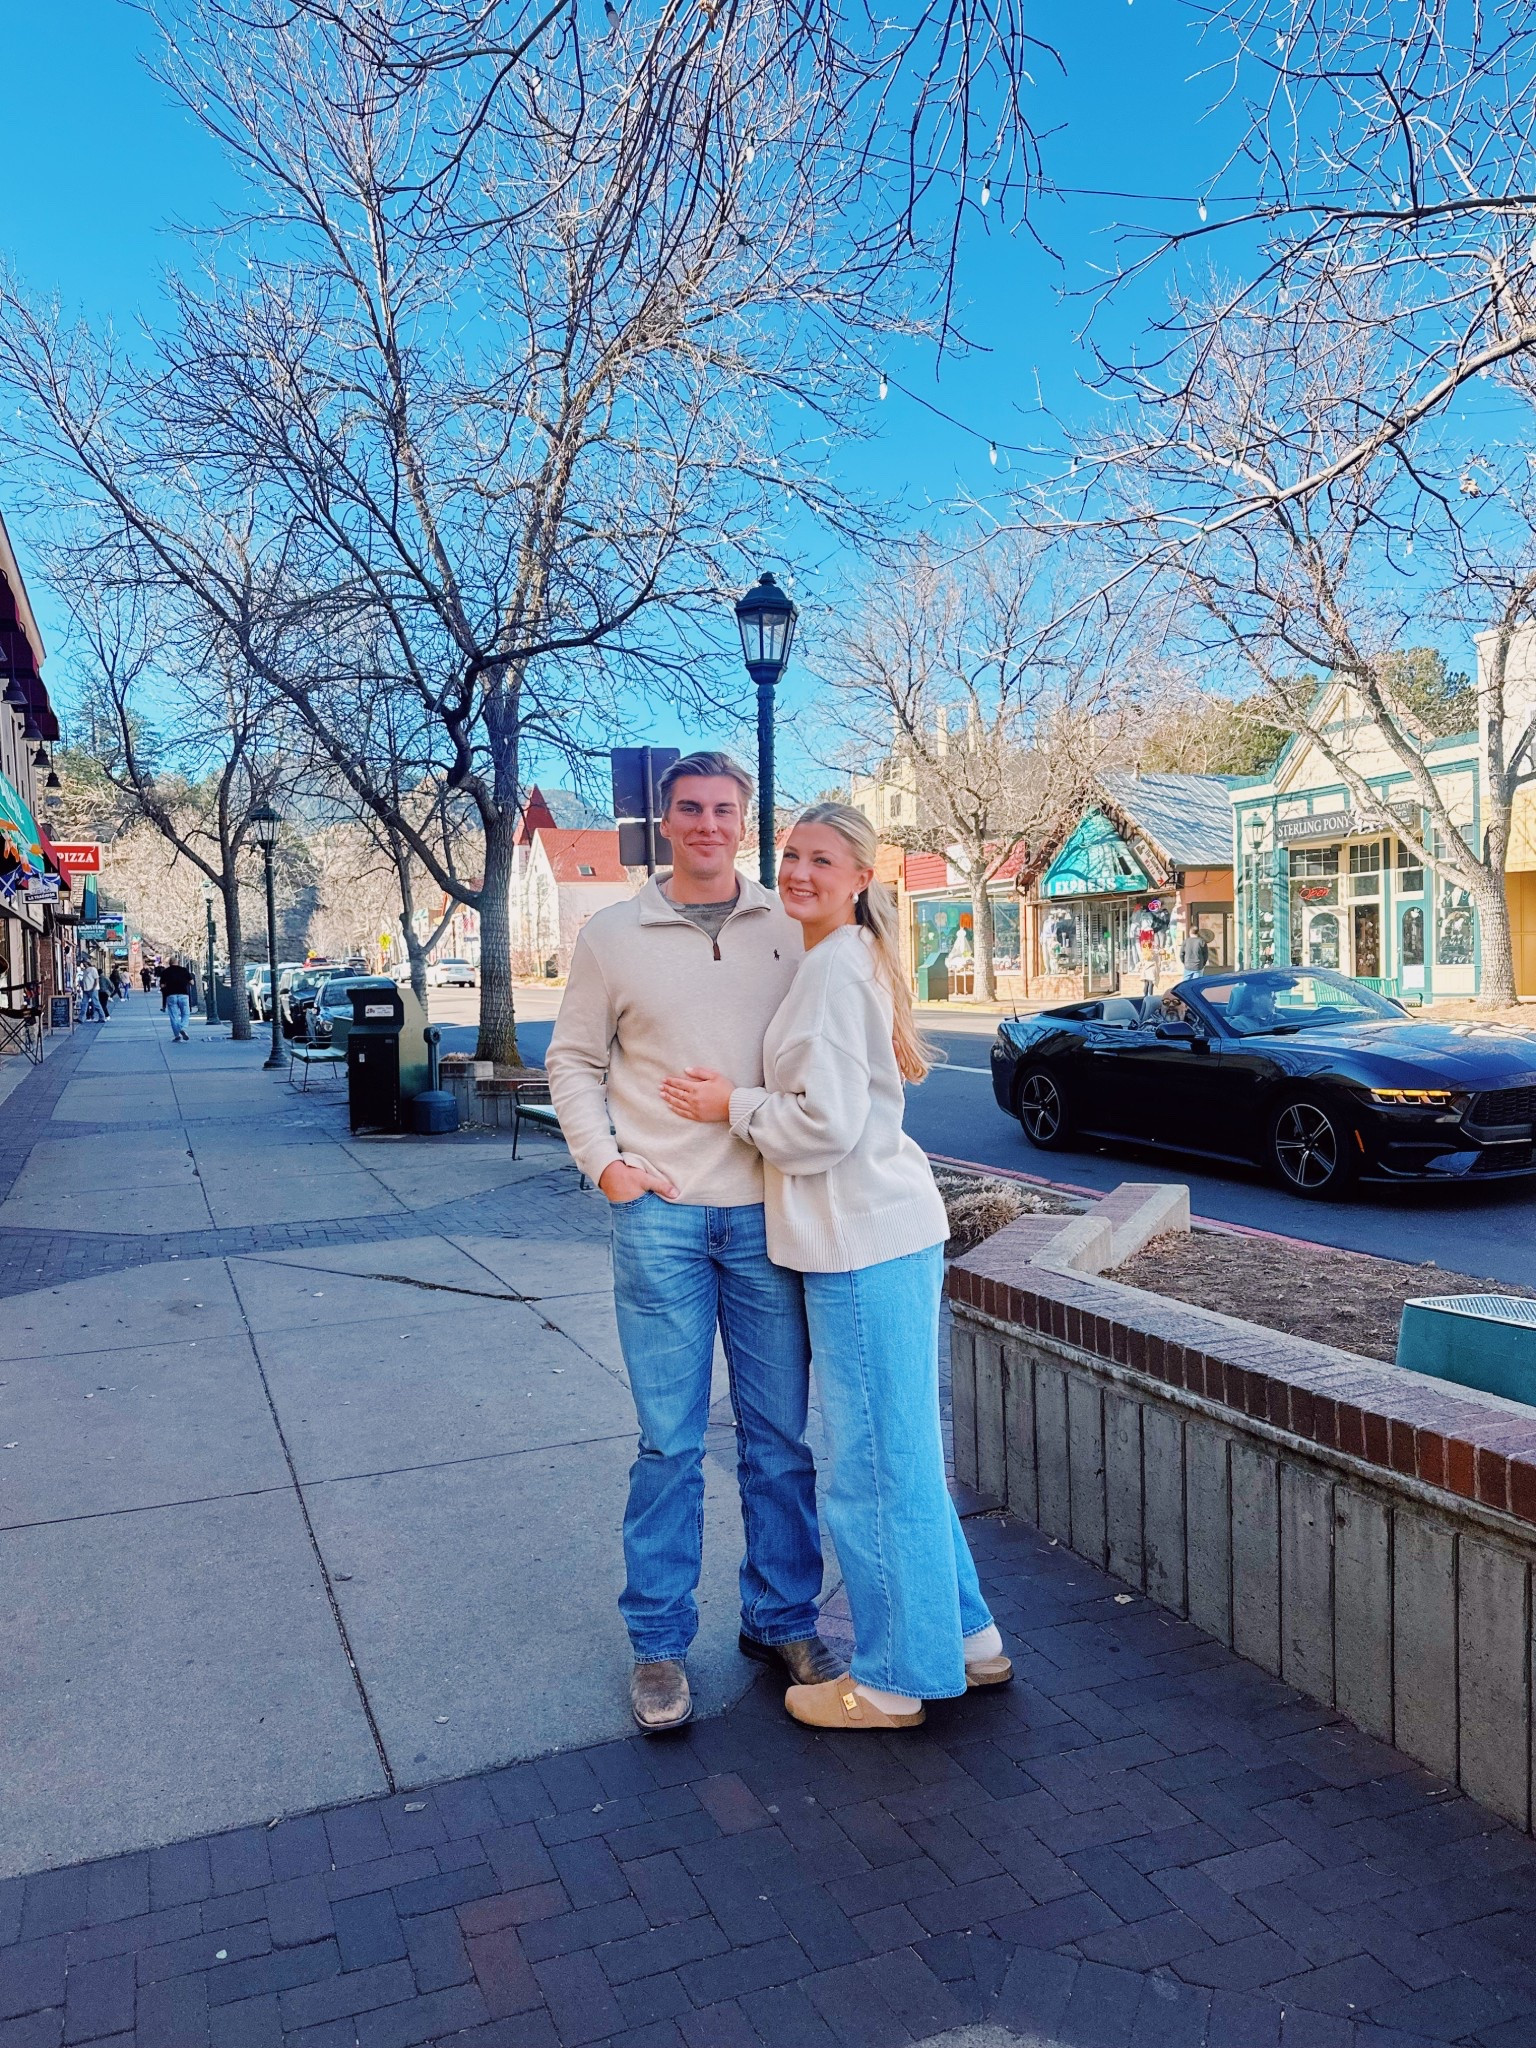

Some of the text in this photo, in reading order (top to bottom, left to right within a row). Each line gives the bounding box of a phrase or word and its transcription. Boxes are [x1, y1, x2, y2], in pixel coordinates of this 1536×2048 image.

[1278, 815, 1349, 837] STERLING PONY
[57, 852, 95, 863] PIZZA
[1055, 878, 1116, 895] EXPRESS
